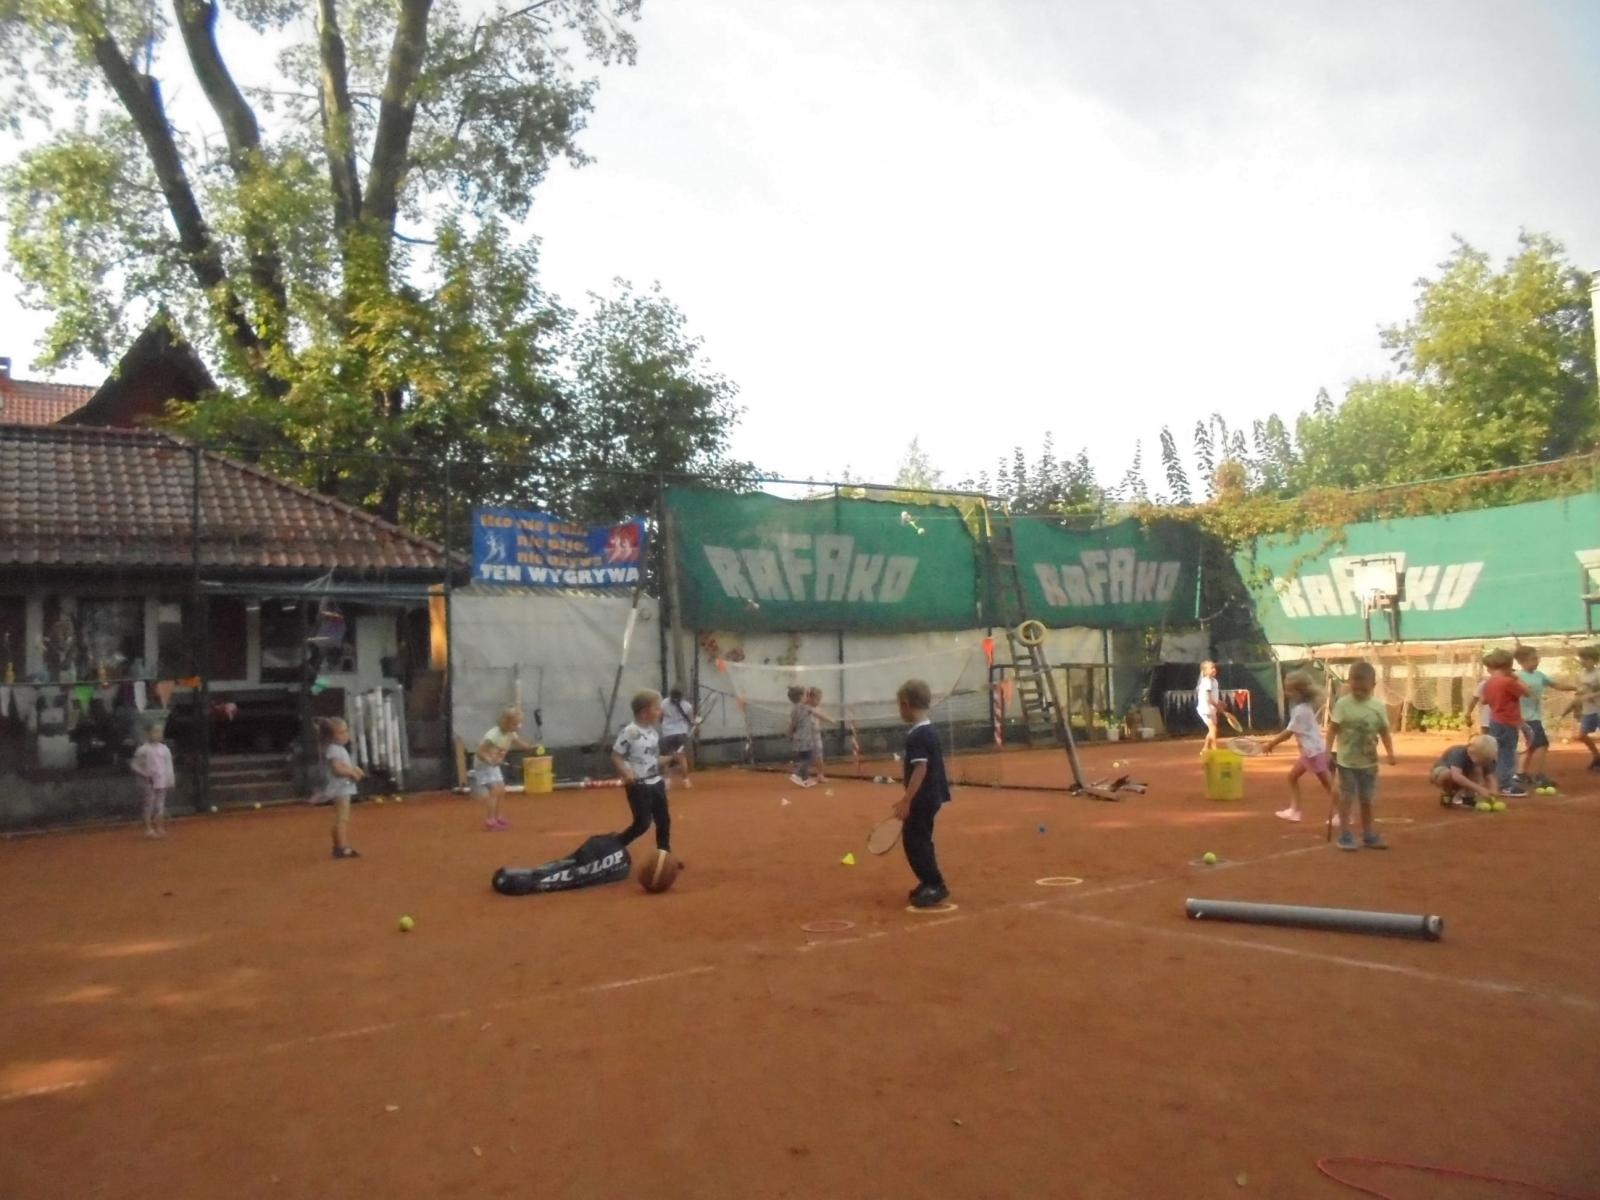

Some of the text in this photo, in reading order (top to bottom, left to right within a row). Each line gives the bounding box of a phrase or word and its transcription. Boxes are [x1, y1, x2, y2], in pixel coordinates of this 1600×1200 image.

[480, 563, 640, 585] TEN WYGRYWA
[703, 533, 919, 603] RAFAKO
[1033, 547, 1181, 606] RAFAKO
[1272, 551, 1485, 618] RAFKO
